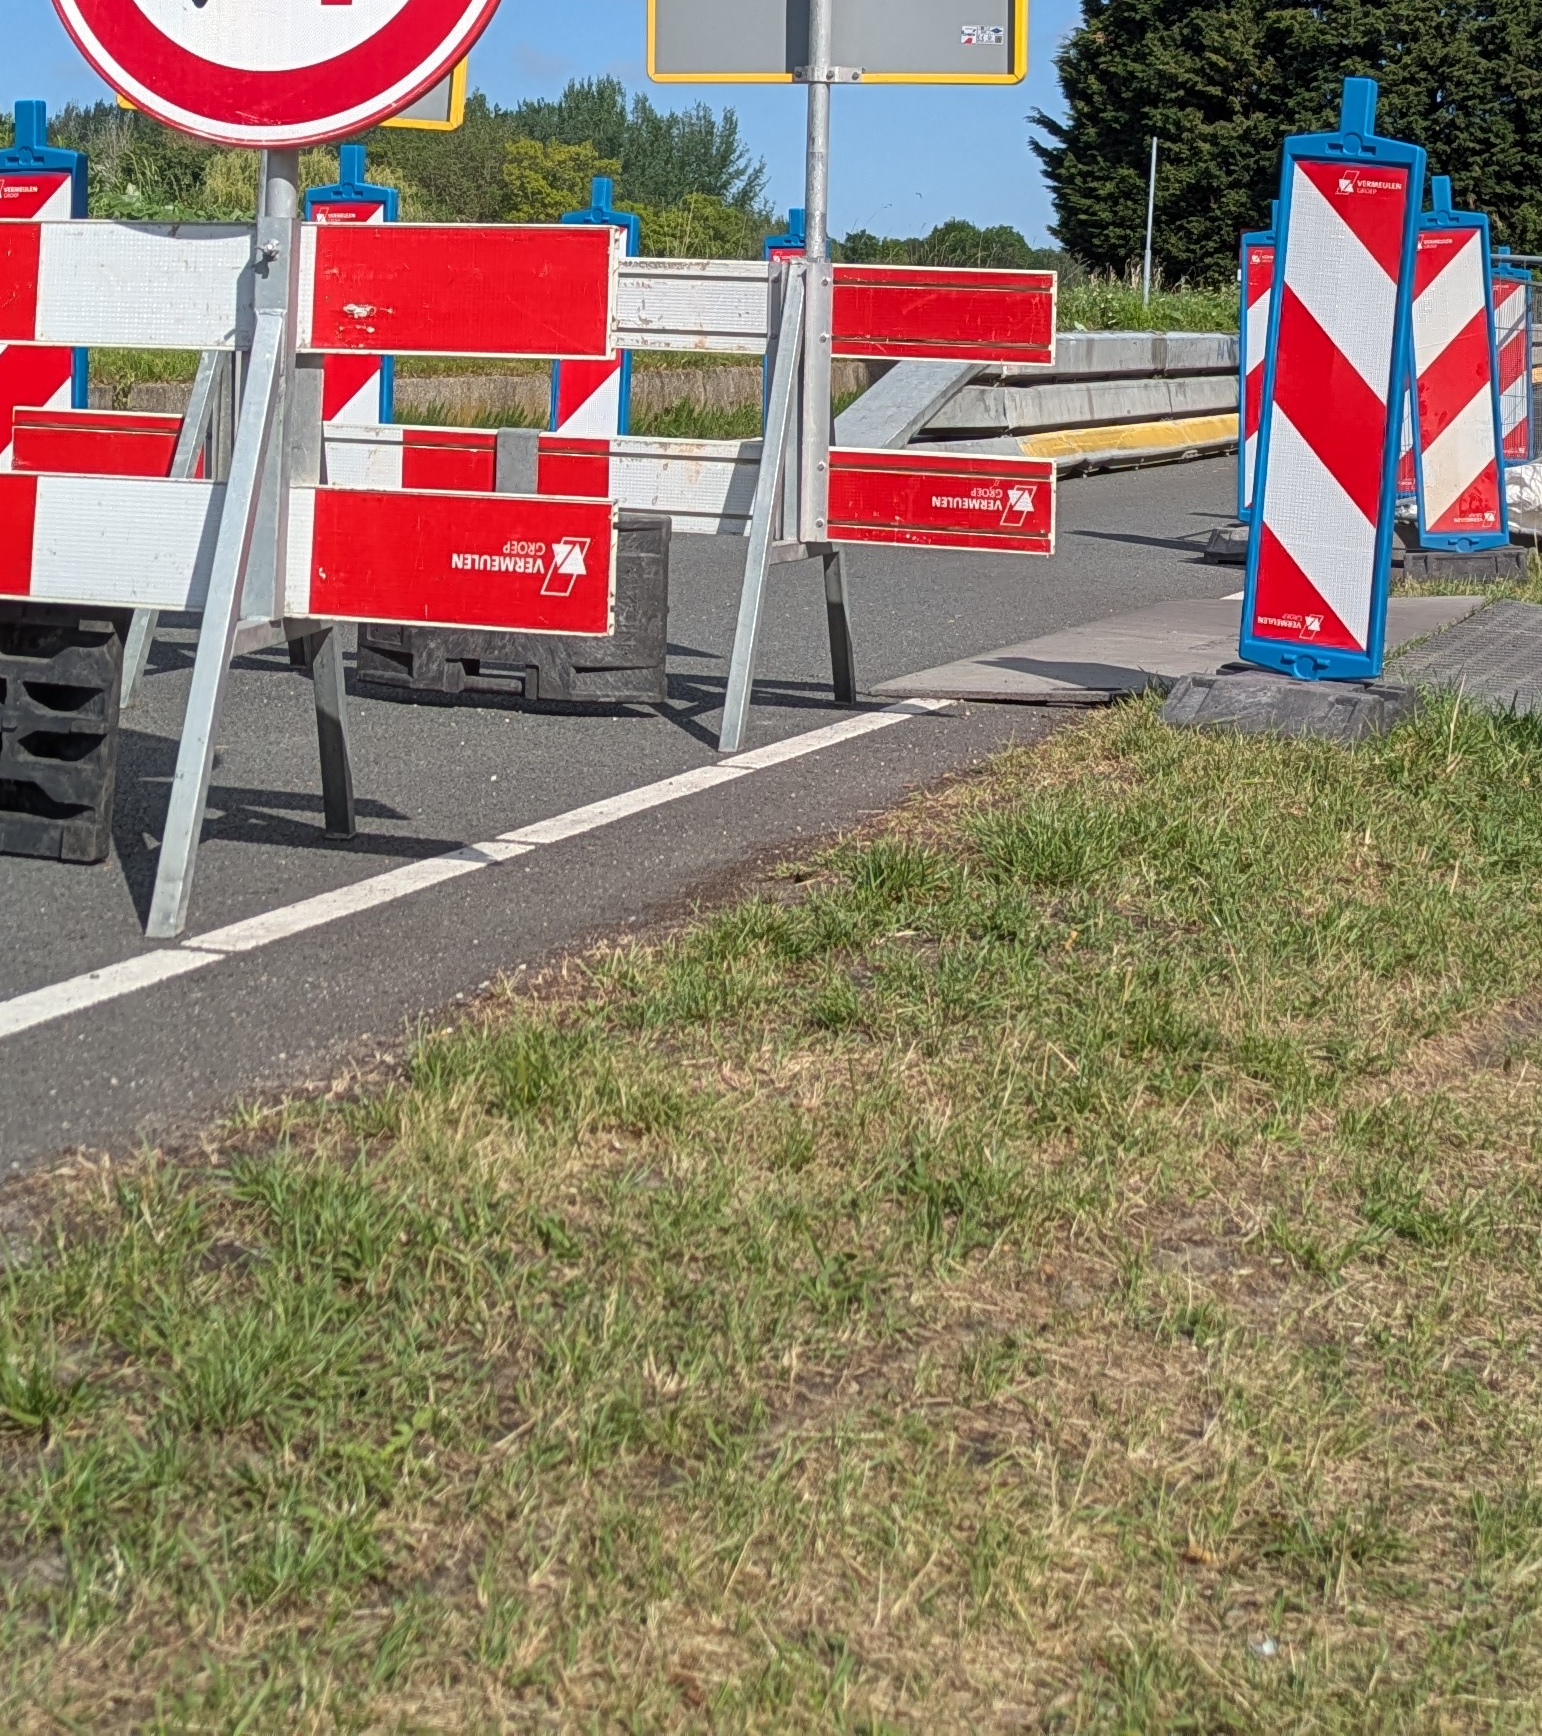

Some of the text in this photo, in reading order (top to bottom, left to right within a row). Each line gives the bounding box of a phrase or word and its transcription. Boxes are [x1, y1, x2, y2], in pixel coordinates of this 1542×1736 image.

[1356, 180, 1402, 190] VERMEULEN
[970, 487, 1003, 499] GROEP
[931, 495, 1003, 511] VERMEULEN
[502, 540, 546, 556] GROEP
[451, 553, 545, 574] VERMEULEN
